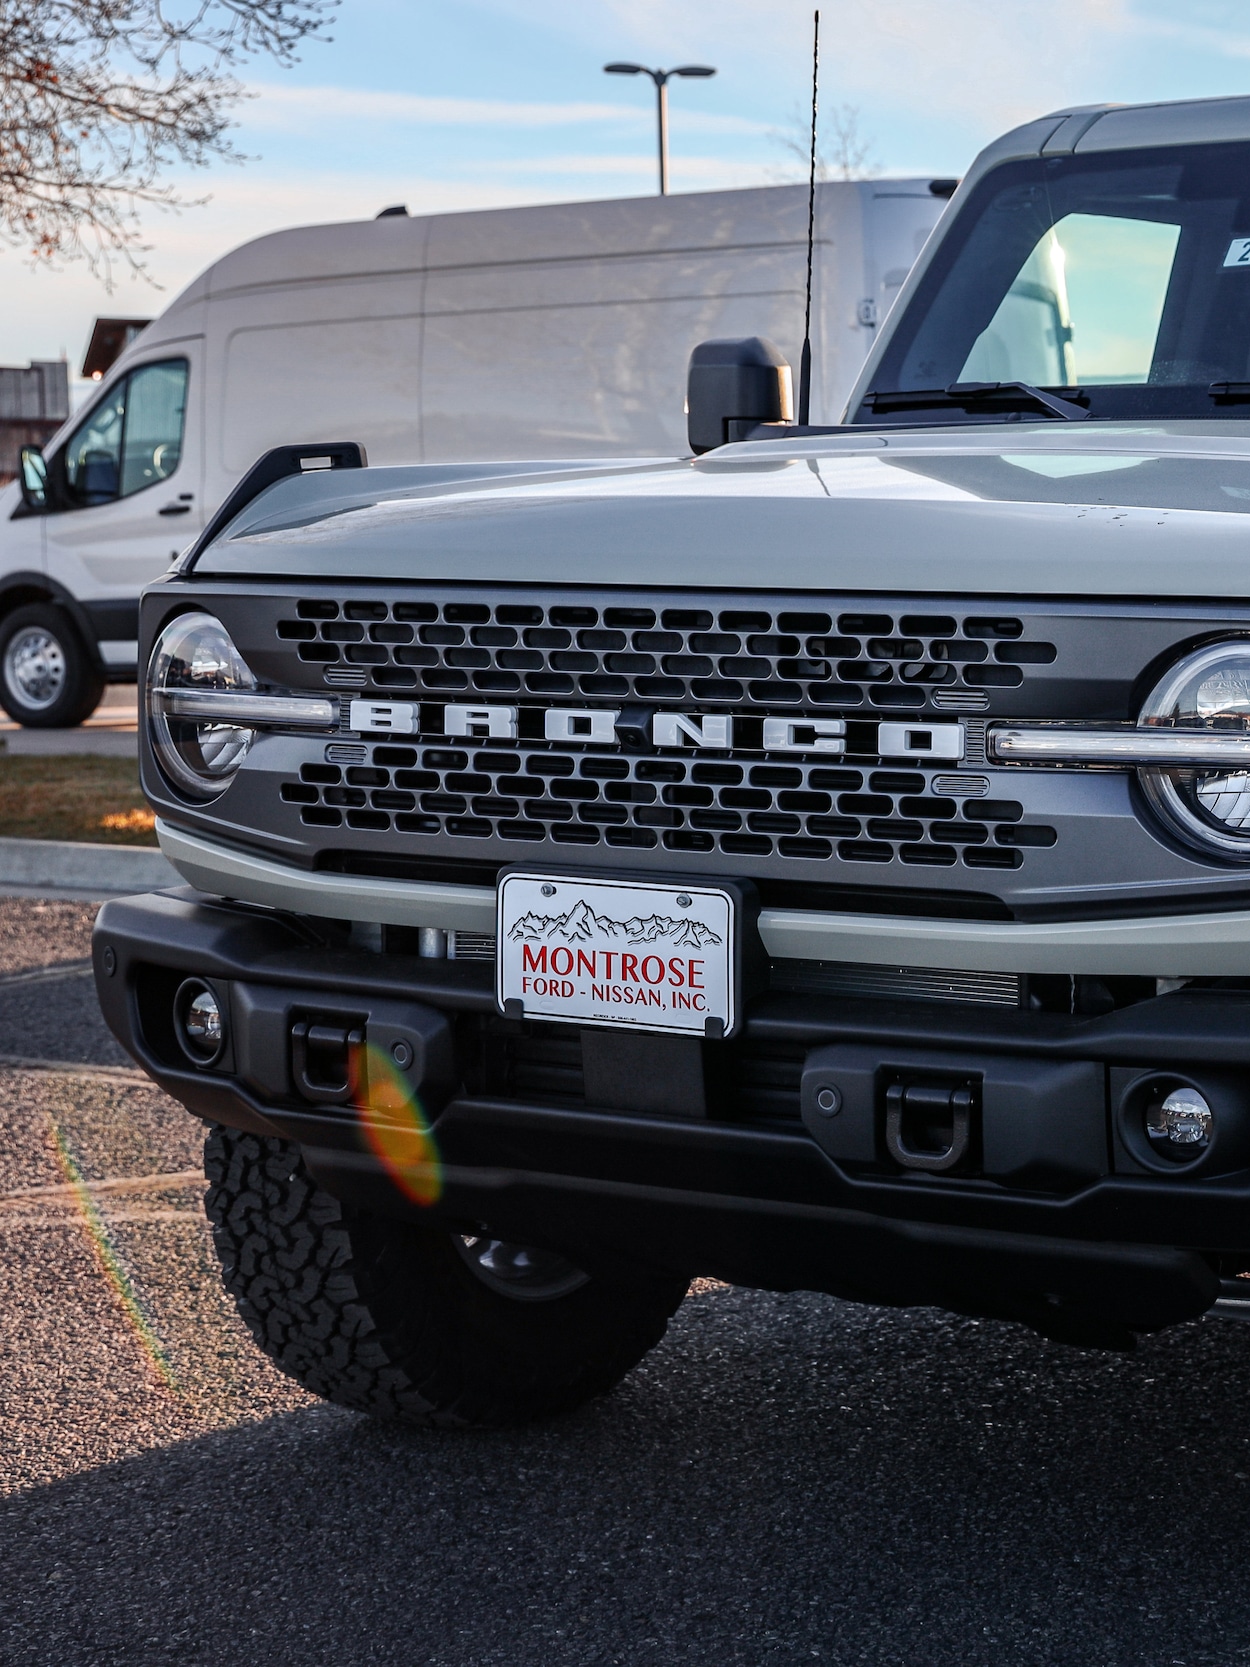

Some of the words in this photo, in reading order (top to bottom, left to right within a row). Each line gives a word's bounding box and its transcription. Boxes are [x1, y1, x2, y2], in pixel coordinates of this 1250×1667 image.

[349, 700, 965, 758] BRONCO
[521, 943, 706, 990] MONTROSE
[521, 976, 575, 999] FORD
[591, 983, 667, 1010] NISSAN,
[671, 990, 711, 1012] INC.
